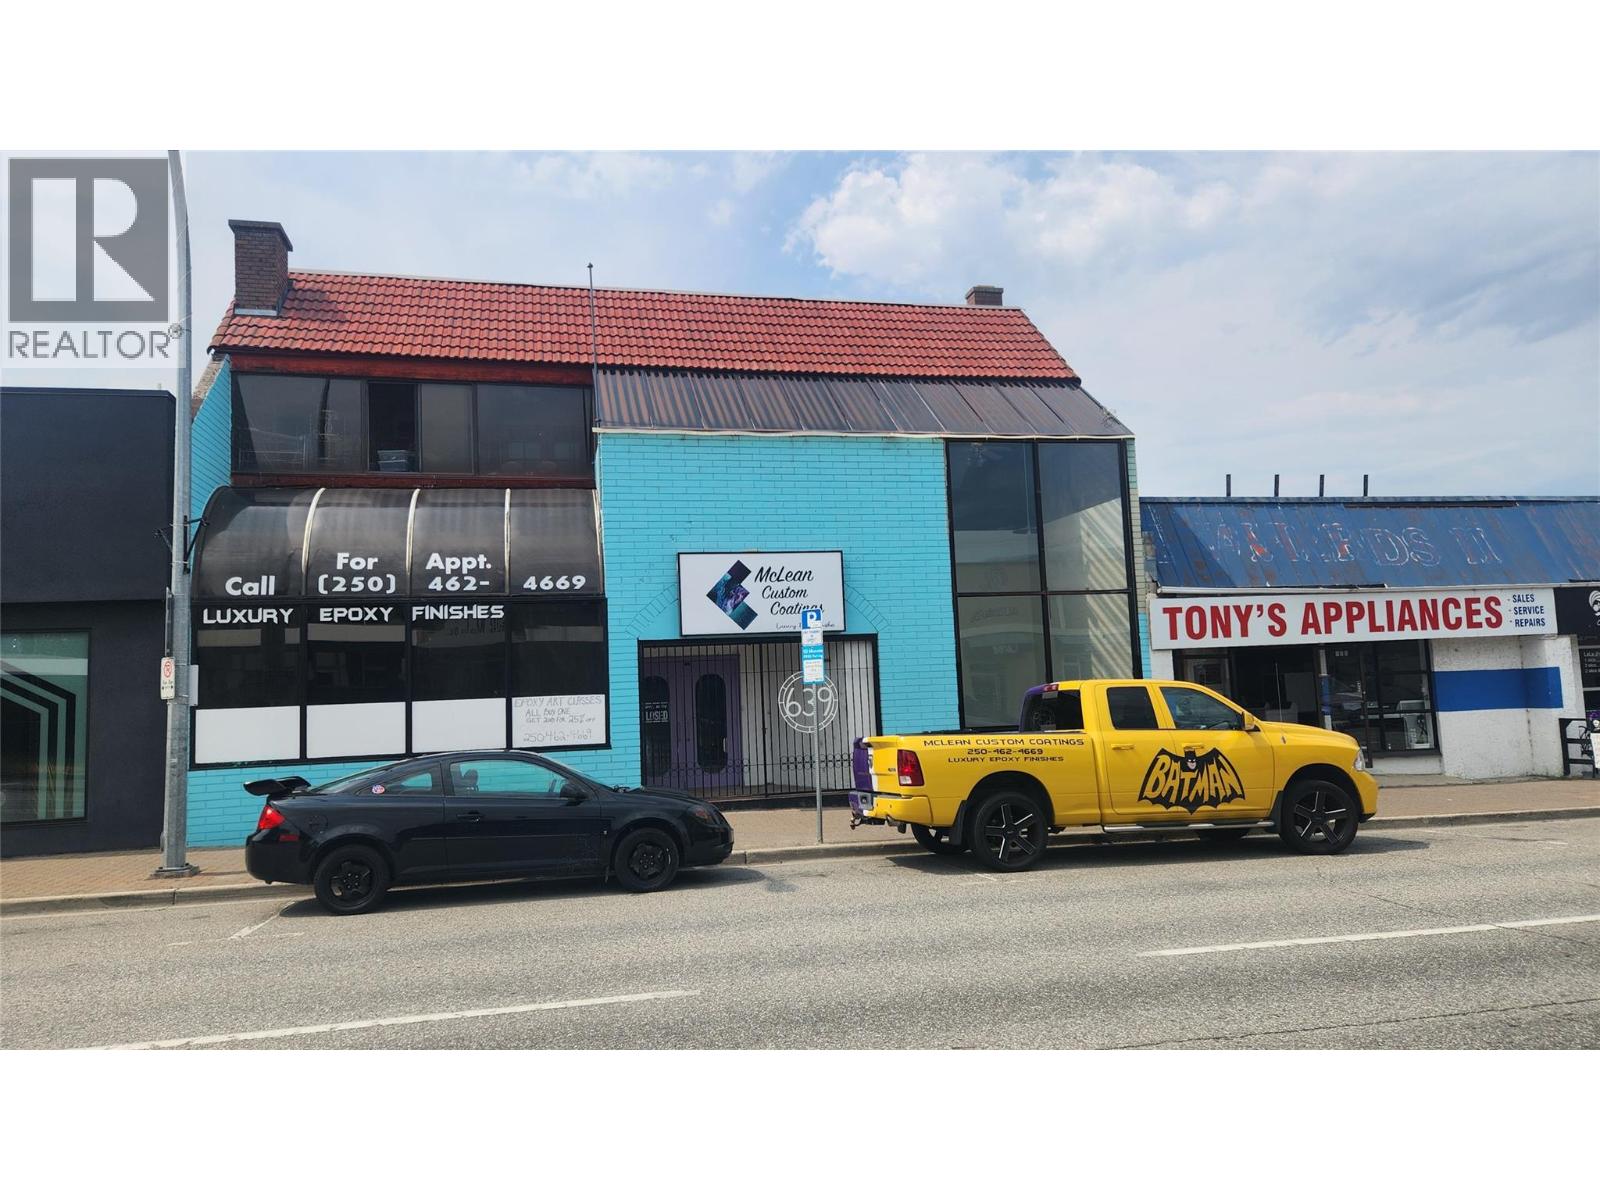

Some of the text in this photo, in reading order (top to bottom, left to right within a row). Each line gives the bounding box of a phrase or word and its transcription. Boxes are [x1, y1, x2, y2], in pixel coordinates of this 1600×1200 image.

[336, 552, 492, 580] For Appt.
[754, 566, 814, 583] McLean
[225, 575, 586, 596] Call (250) 462- 4669
[761, 585, 808, 600] Custom
[1512, 593, 1535, 603] SALES
[203, 604, 504, 625] LUXURY EPOXY FINISHES
[1162, 595, 1503, 641] TONY'S APPLIANCES
[1513, 605, 1545, 615] SERVICE
[1515, 617, 1546, 627] REPAIRS
[547, 697, 563, 706] ART
[785, 686, 833, 718] 639
[923, 738, 1085, 747] MCLEAN CUSTOM COATINGS
[1143, 754, 1242, 804] BATMAN
